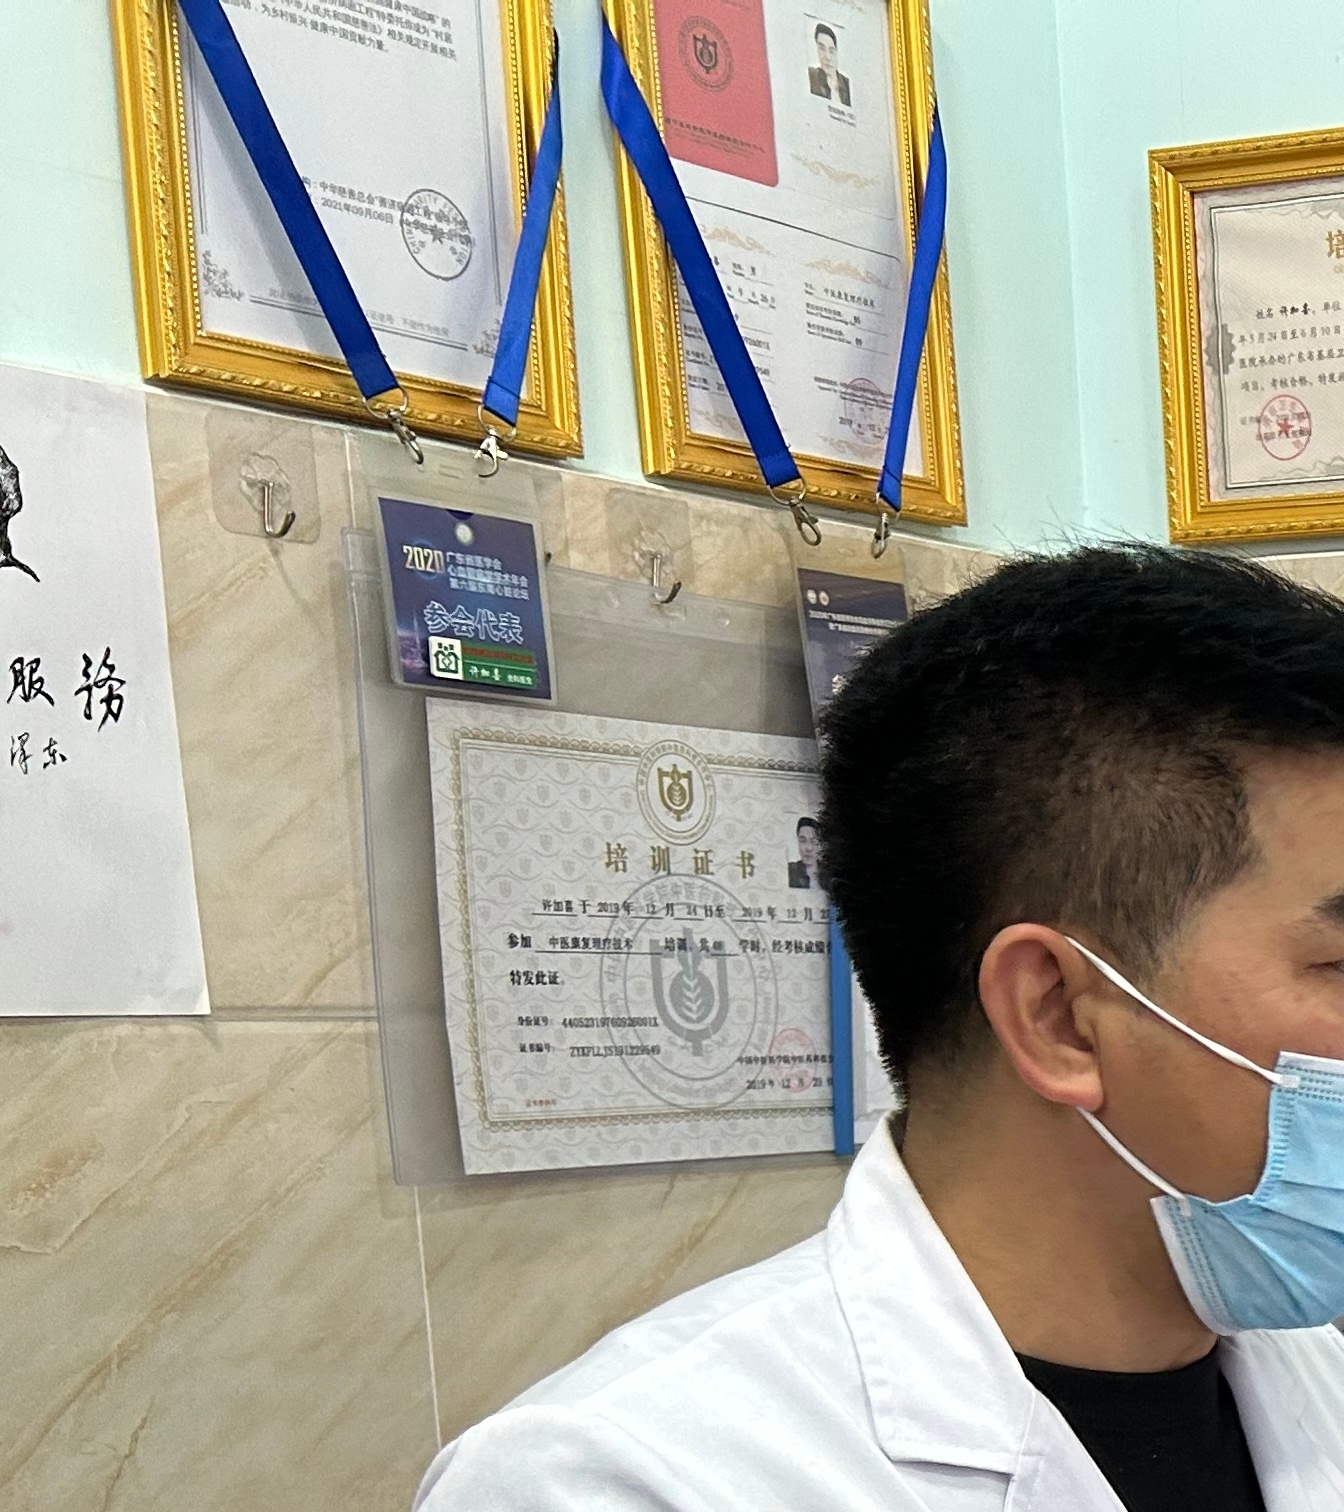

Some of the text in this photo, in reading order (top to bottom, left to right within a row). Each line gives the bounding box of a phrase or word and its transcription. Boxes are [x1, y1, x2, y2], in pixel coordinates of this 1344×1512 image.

[402, 545, 446, 574] 2020
[423, 600, 524, 645] 参会代表
[605, 842, 756, 880] 培训证书
[508, 932, 532, 948] 参加
